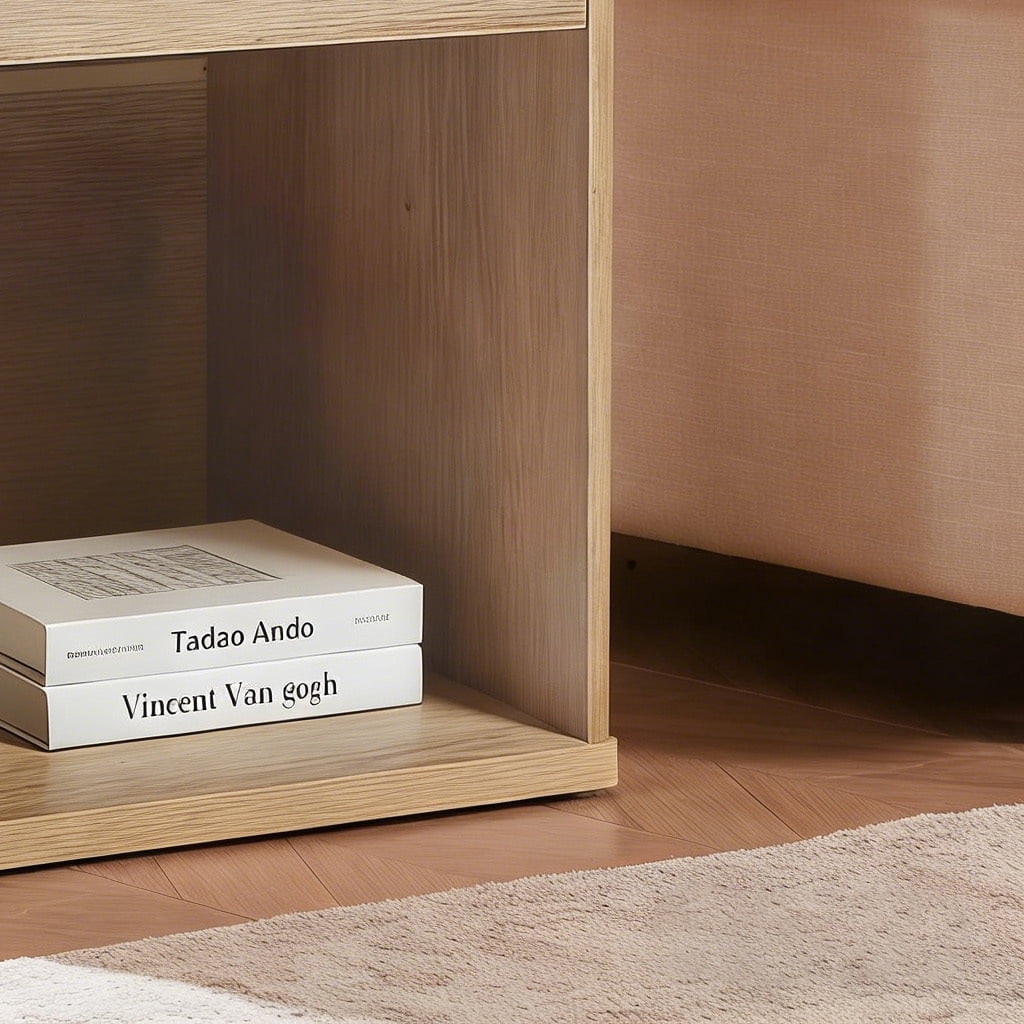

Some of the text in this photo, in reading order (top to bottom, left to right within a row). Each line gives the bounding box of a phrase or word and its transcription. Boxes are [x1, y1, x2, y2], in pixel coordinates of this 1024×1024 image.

[171, 626, 245, 653] Tadao
[252, 615, 314, 644] Ando
[122, 671, 338, 720] Vincent Van gogh
